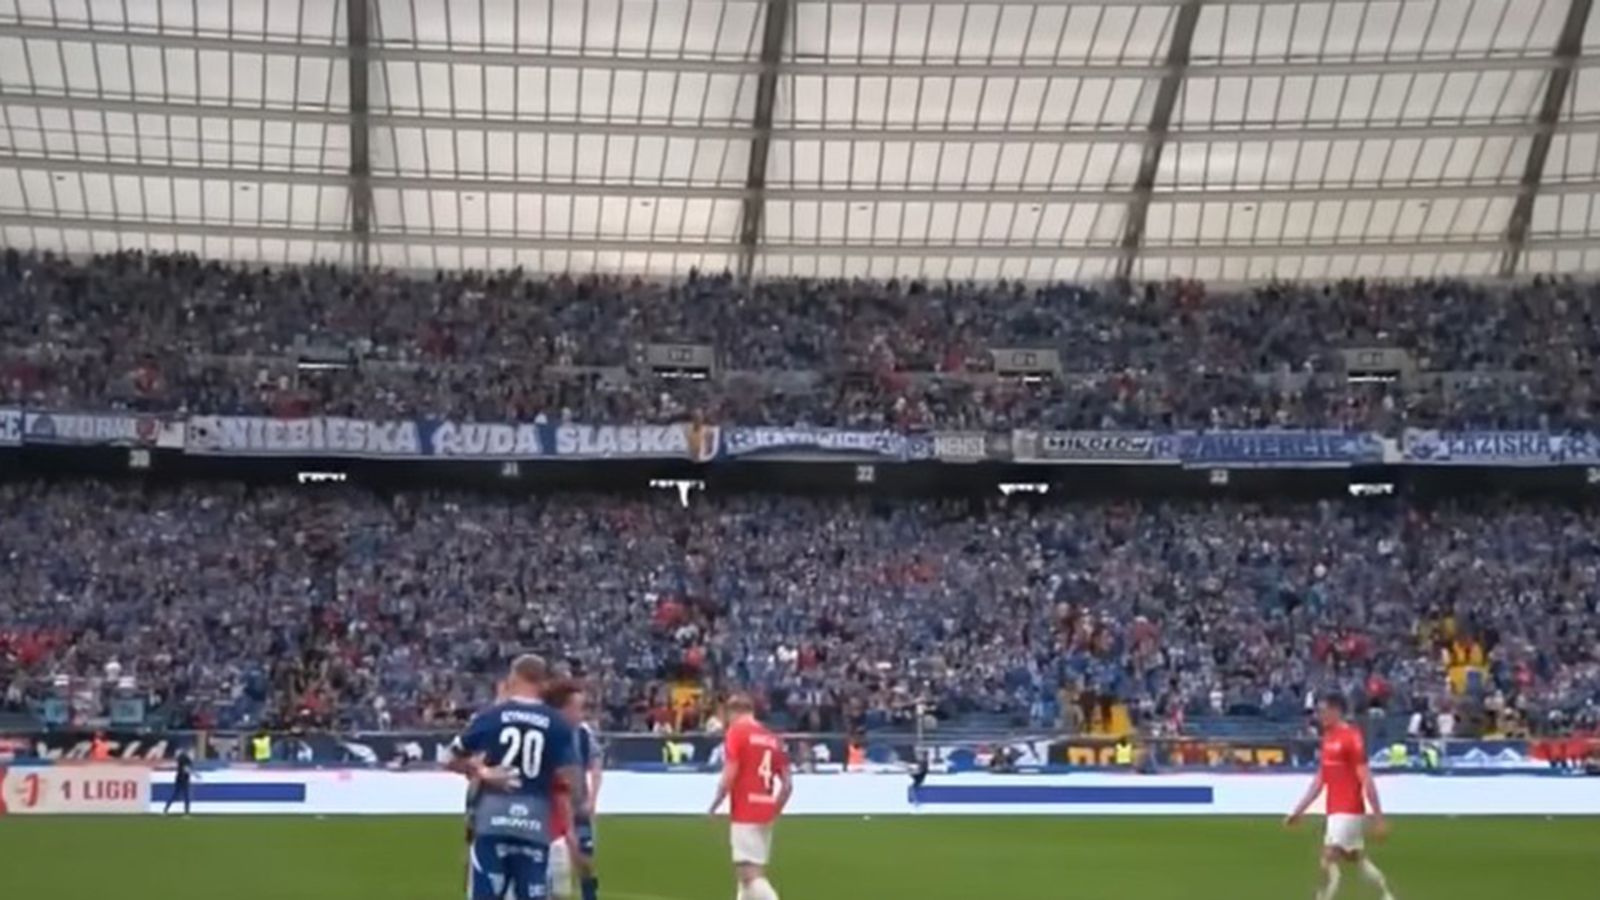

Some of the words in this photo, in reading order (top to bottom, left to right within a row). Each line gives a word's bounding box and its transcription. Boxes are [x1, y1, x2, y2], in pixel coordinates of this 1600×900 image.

[218, 418, 421, 453] NIEBIESKA
[500, 726, 545, 779] 20
[758, 749, 772, 790] 4
[61, 780, 72, 799] 1
[83, 780, 138, 799] LIGA
